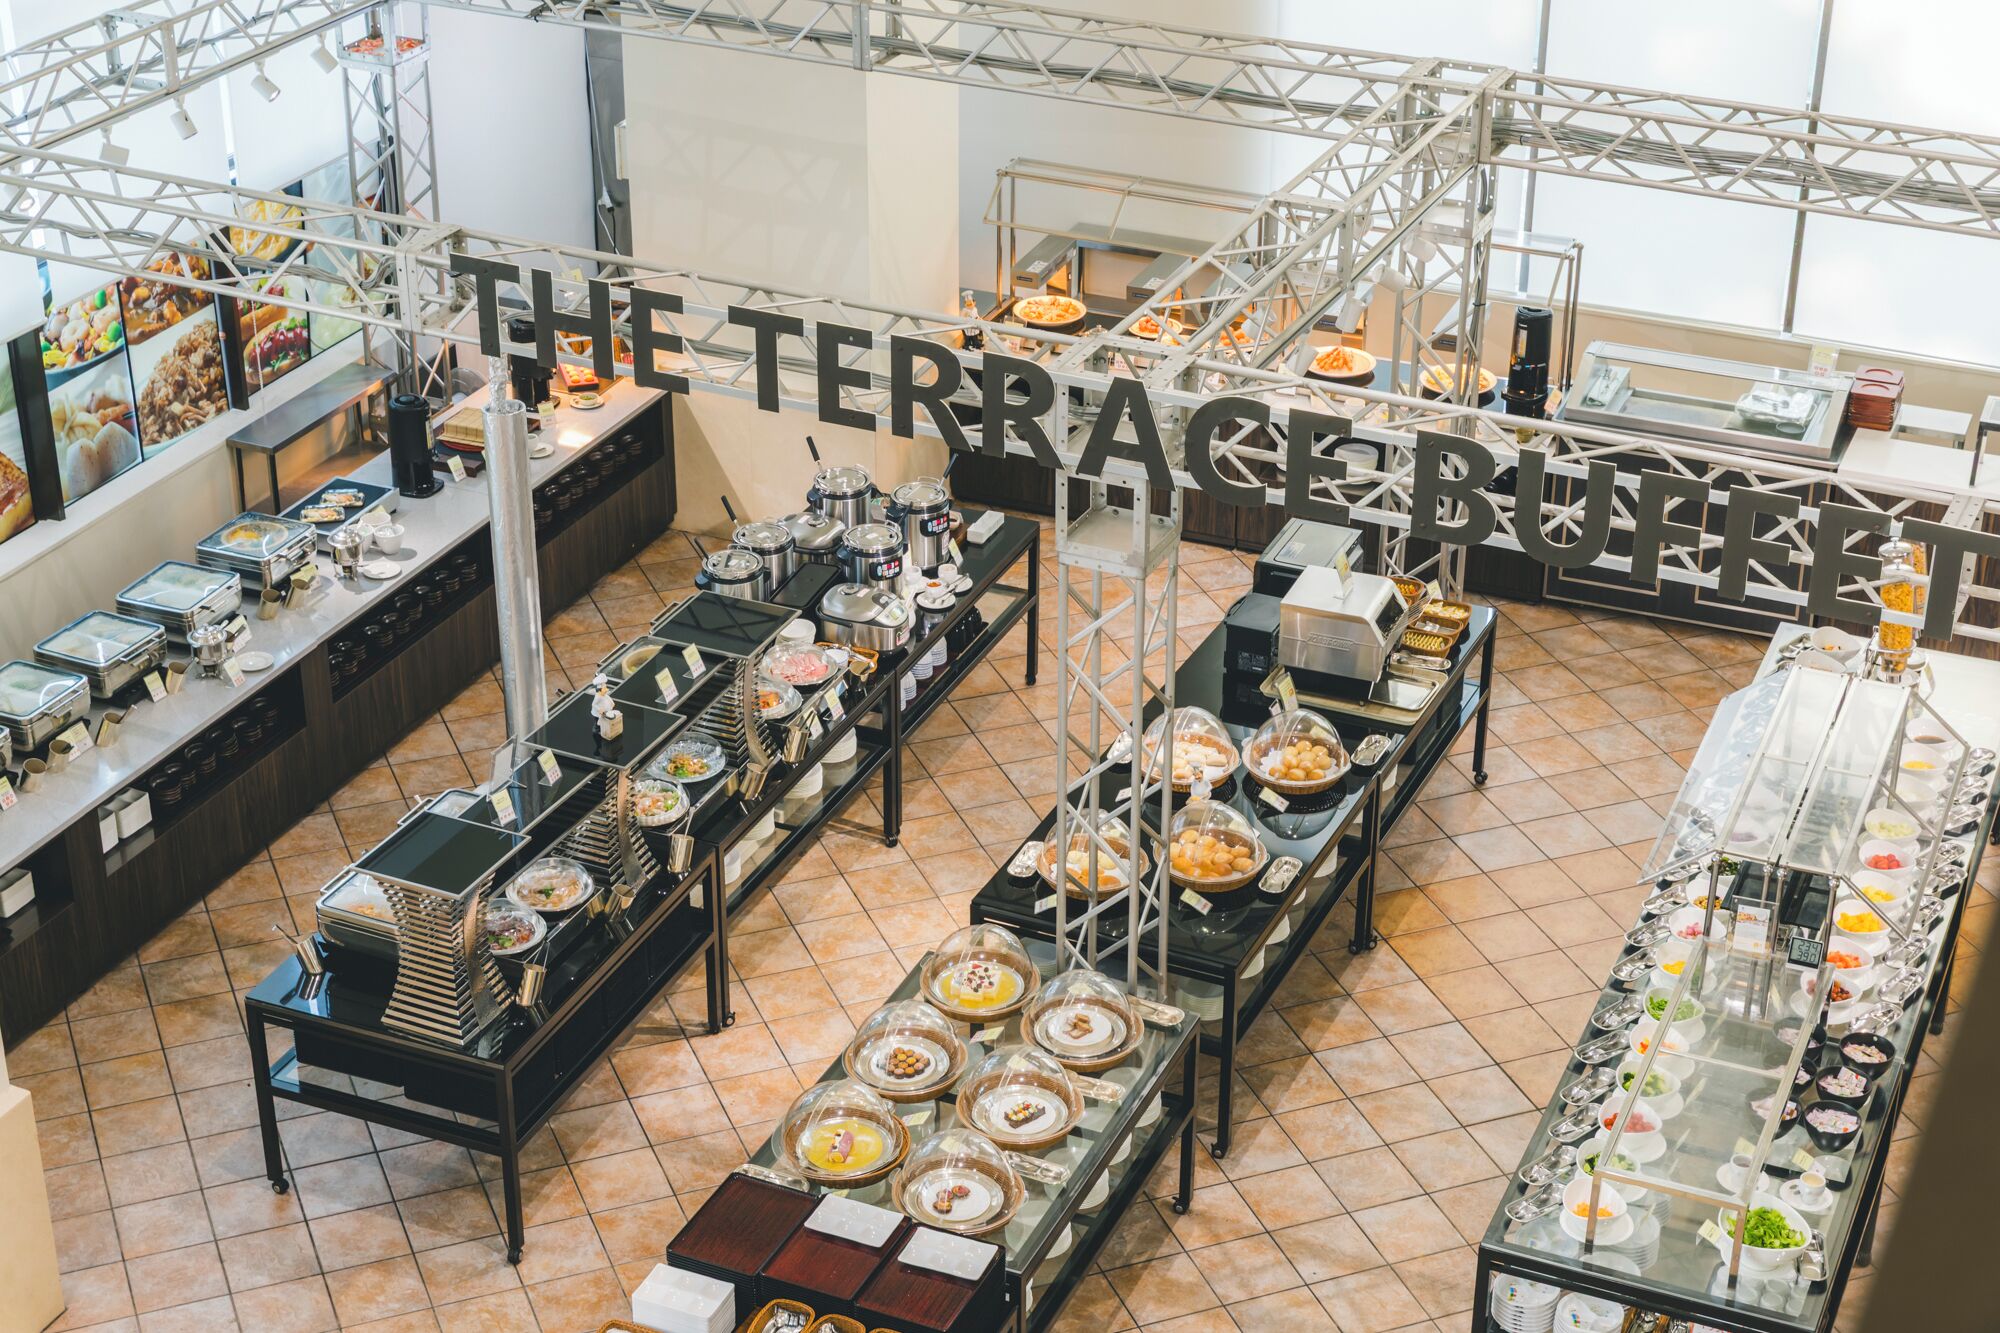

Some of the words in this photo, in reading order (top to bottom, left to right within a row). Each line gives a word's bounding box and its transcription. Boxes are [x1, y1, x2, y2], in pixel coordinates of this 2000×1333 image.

[451, 253, 689, 395] THE
[728, 305, 1352, 525] TERRACE
[1411, 430, 2000, 641] BUFFET
